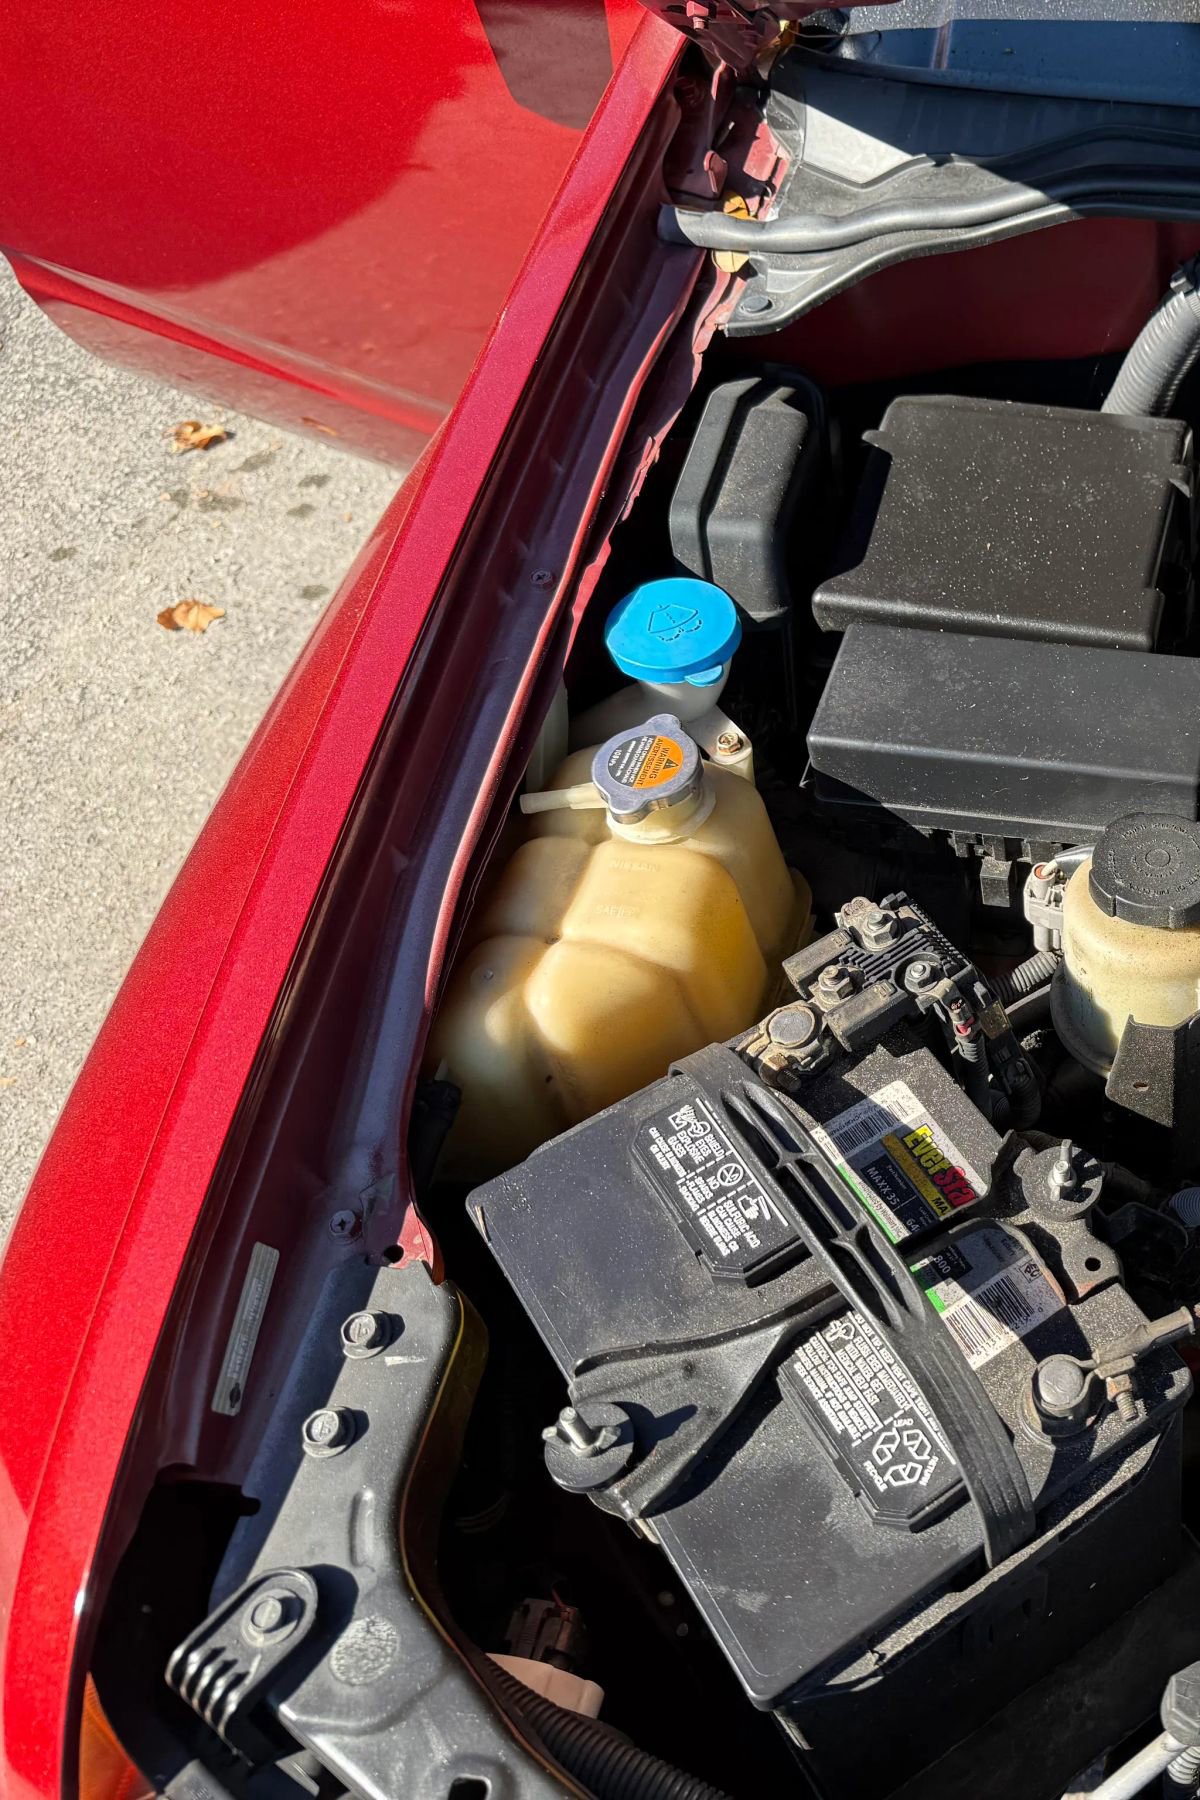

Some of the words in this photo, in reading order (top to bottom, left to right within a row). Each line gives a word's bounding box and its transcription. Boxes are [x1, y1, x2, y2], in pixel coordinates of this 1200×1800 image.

[636, 737, 663, 787] AVERTISSEMENT
[648, 745, 670, 780] WARNING
[666, 1134, 687, 1158] GASES
[675, 1128, 705, 1165] EXPLOSIVE
[694, 1137, 712, 1157] EYES
[703, 1132, 725, 1158] SHIELD
[901, 1122, 982, 1208] EverSta
[705, 1174, 721, 1190] NO
[866, 1165, 891, 1195] MAXX
[885, 1191, 900, 1206] 35
[714, 1204, 729, 1220] CAN
[722, 1216, 742, 1239] CAUSE
[931, 1196, 950, 1214] MA
[722, 1198, 751, 1233] SULFURIC
[742, 1228, 761, 1249] ACID
[727, 1239, 740, 1253] OR
[933, 1254, 951, 1274] 800
[824, 1358, 838, 1374] FOR
[834, 1347, 859, 1377] MEDICAL
[851, 1371, 870, 1392] HELP
[862, 1386, 880, 1407] FAST
[843, 1340, 862, 1361] WITH
[868, 1377, 885, 1394] GET
[852, 1334, 873, 1358] FLUSH
[865, 1353, 883, 1373] EYES
[875, 1368, 909, 1410] IMMEDIATELY
[878, 1346, 895, 1366] KEEP
[889, 1362, 907, 1382] VENT
[900, 1378, 919, 1399] CAPS
[912, 1395, 932, 1417] TIGHT
[828, 1396, 843, 1412] NOT
[894, 1418, 912, 1426] LEAD
[862, 1459, 888, 1492] RECYCLE
[919, 1455, 939, 1486] RETURN
